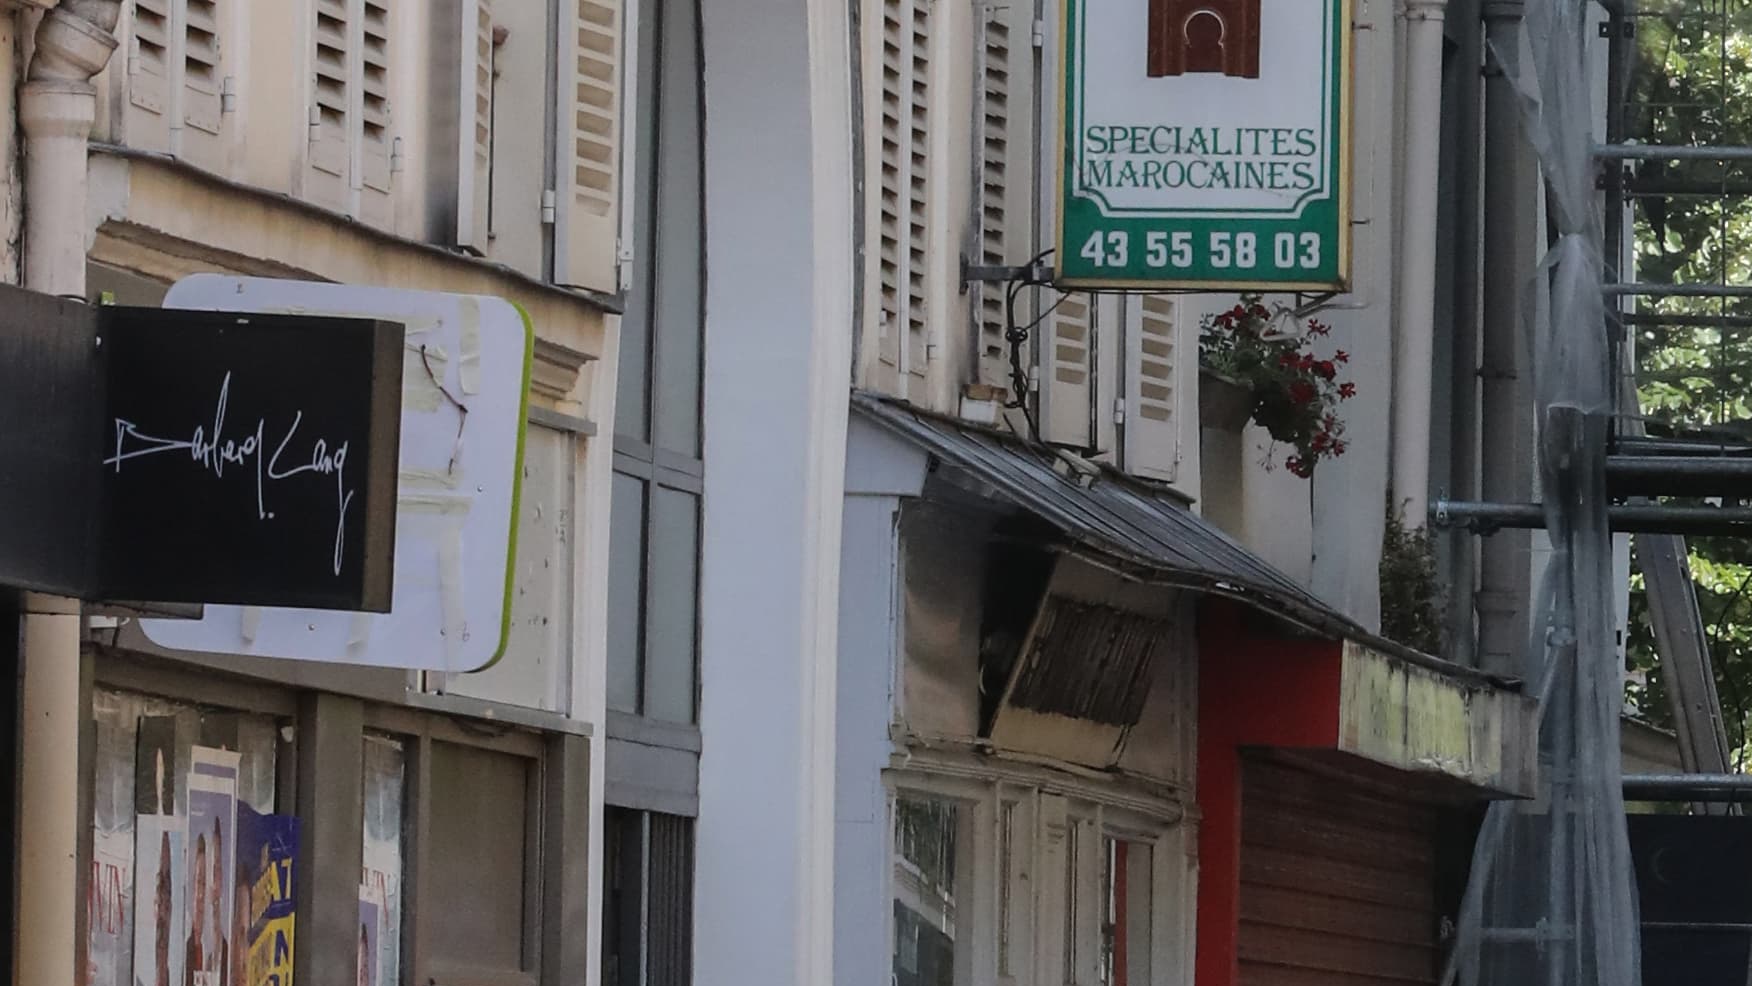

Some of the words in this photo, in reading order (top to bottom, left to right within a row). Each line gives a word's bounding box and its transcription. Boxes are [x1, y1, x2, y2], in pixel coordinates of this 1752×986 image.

[1086, 125, 1317, 156] SPECIALITES
[1087, 159, 1316, 190] MAROCAINES
[1080, 230, 1129, 268] 43
[1146, 231, 1193, 268] 55
[1210, 231, 1256, 268] 58
[1274, 231, 1321, 268] 03
